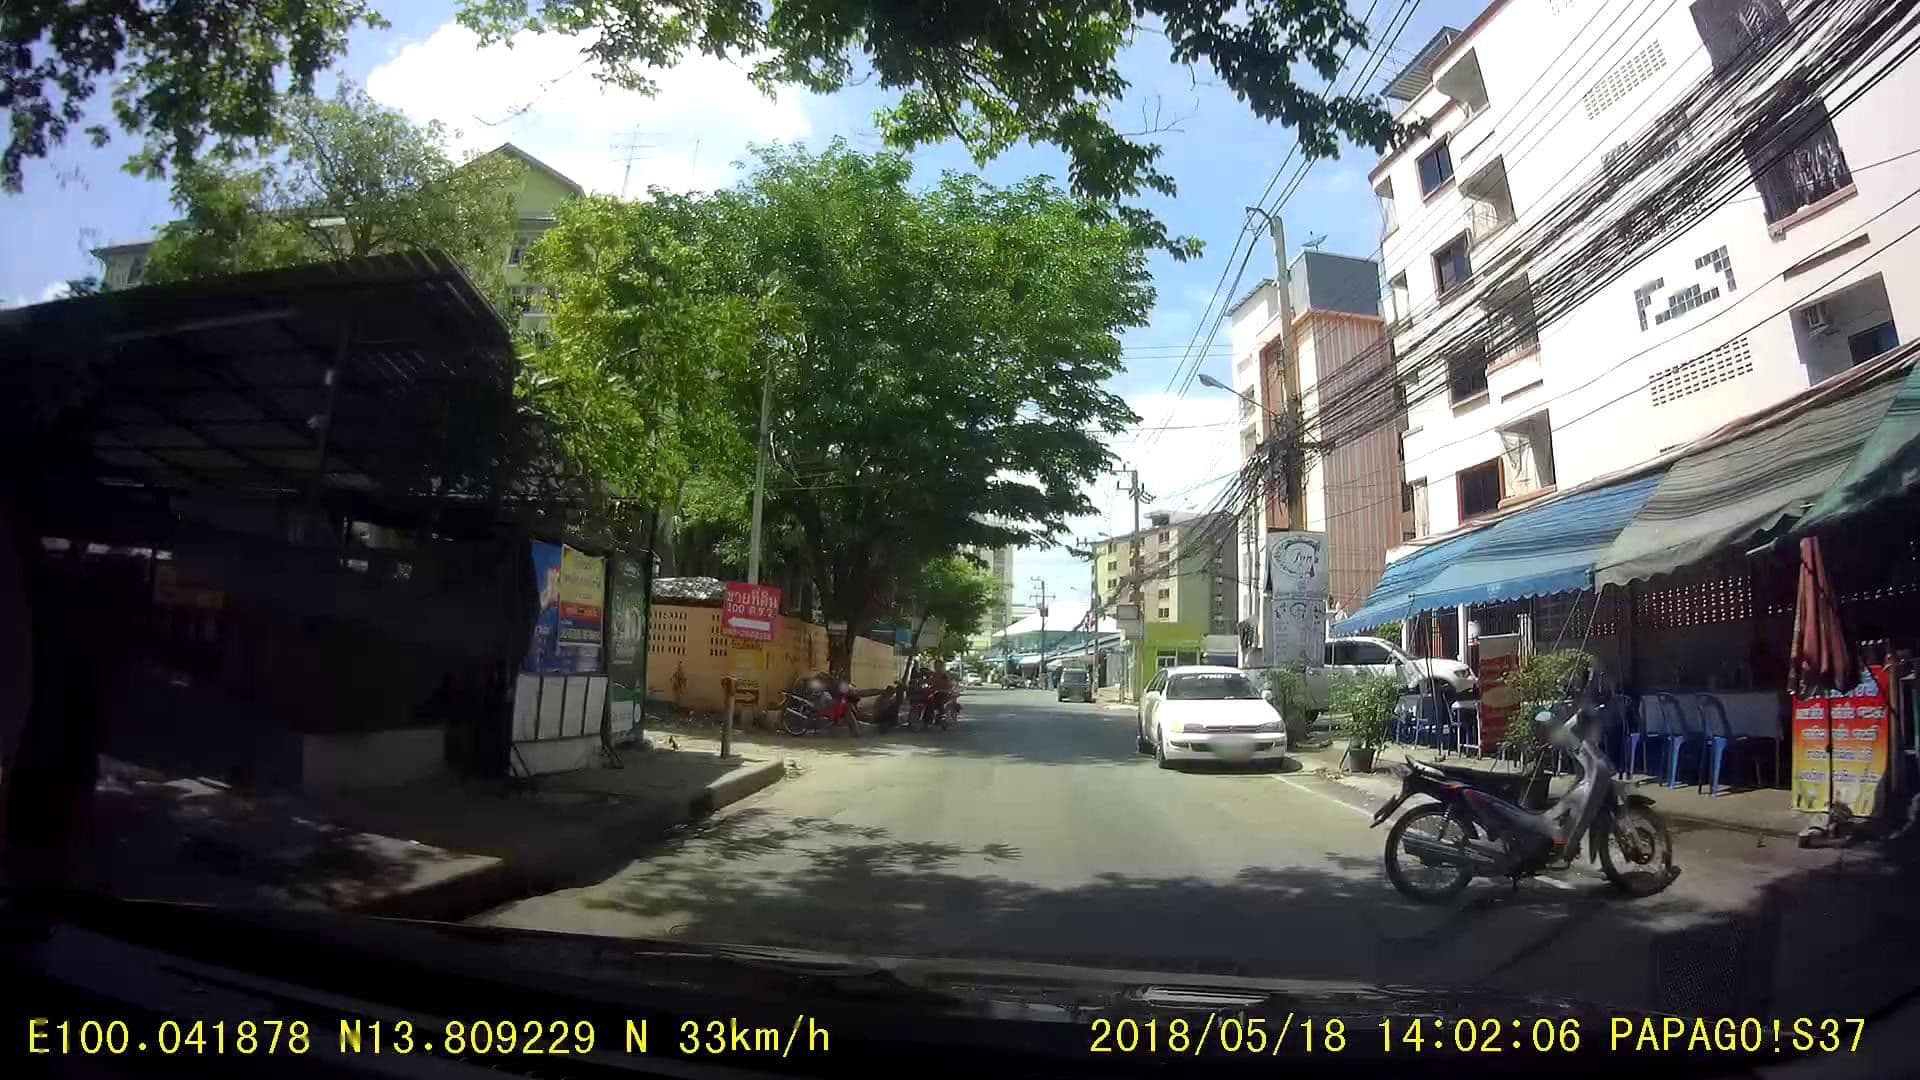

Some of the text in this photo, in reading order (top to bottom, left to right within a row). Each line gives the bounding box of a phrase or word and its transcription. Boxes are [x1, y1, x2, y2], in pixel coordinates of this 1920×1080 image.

[727, 588, 779, 609] ขายที่ดิน
[727, 602, 745, 613] 100
